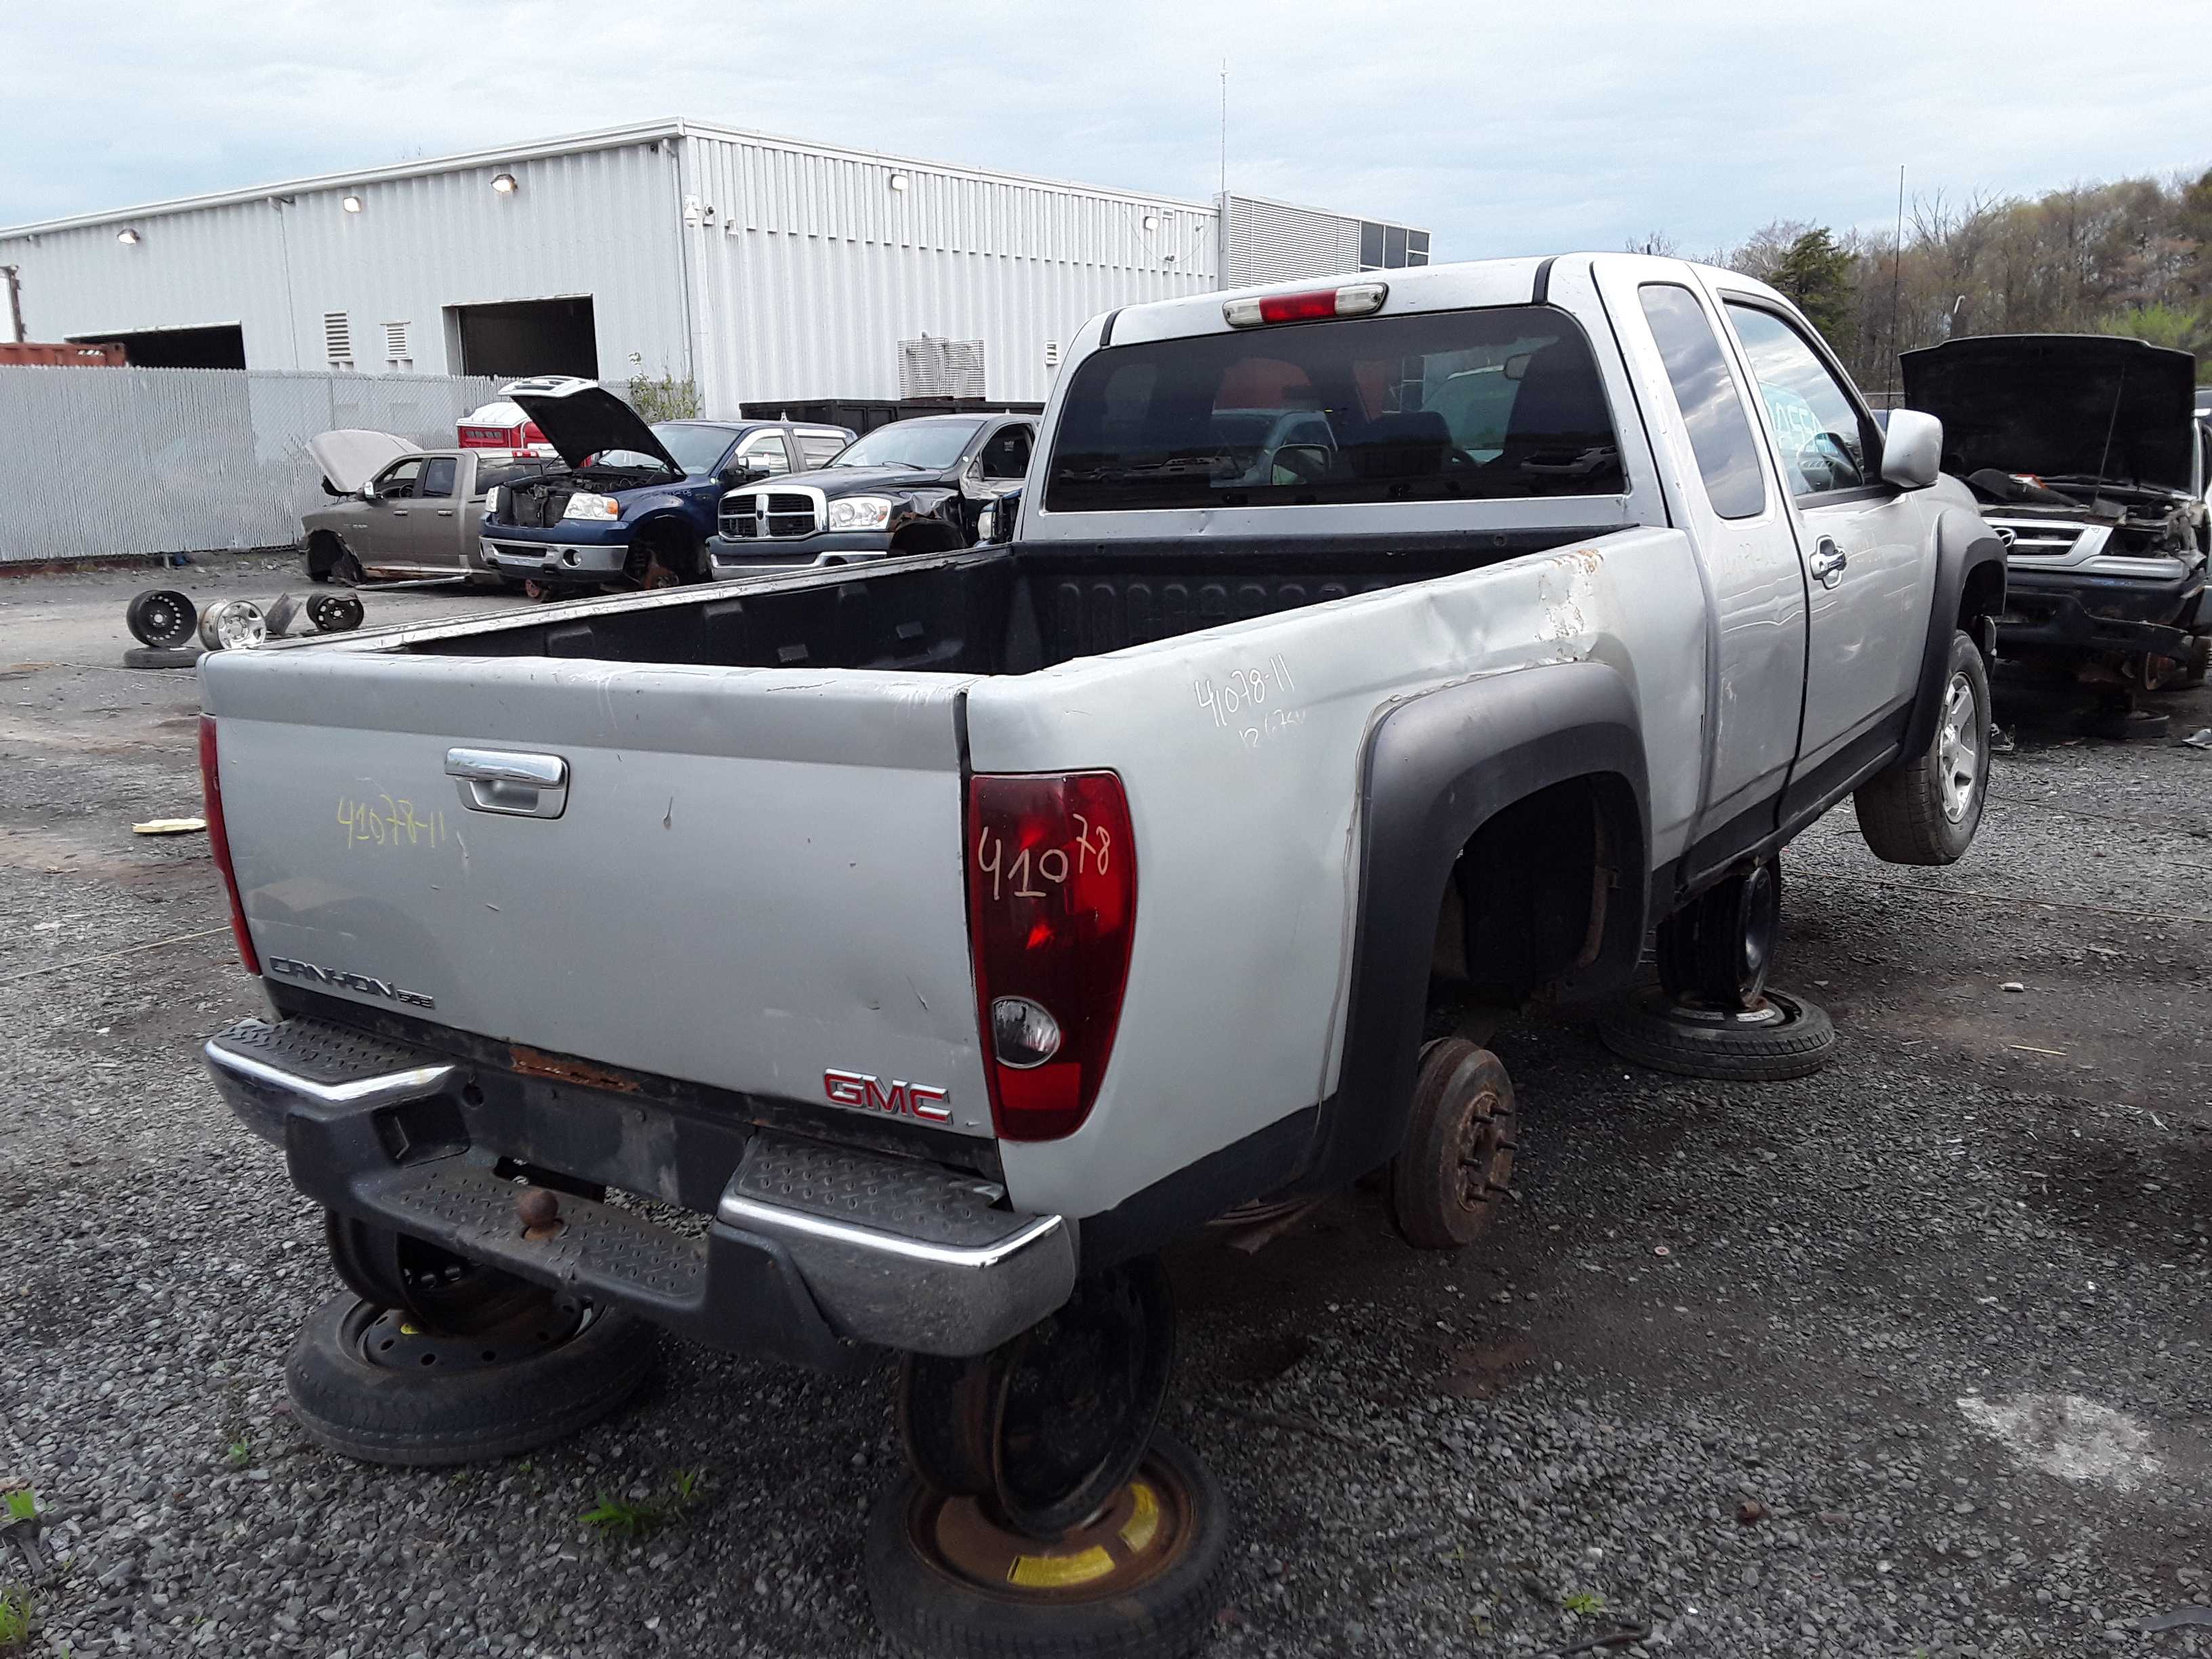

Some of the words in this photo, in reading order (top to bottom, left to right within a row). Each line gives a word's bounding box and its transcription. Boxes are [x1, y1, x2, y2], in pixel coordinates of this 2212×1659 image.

[337, 794, 445, 849] 41078-11
[269, 955, 398, 1001] CANYON
[823, 1068, 953, 1125] GMC
